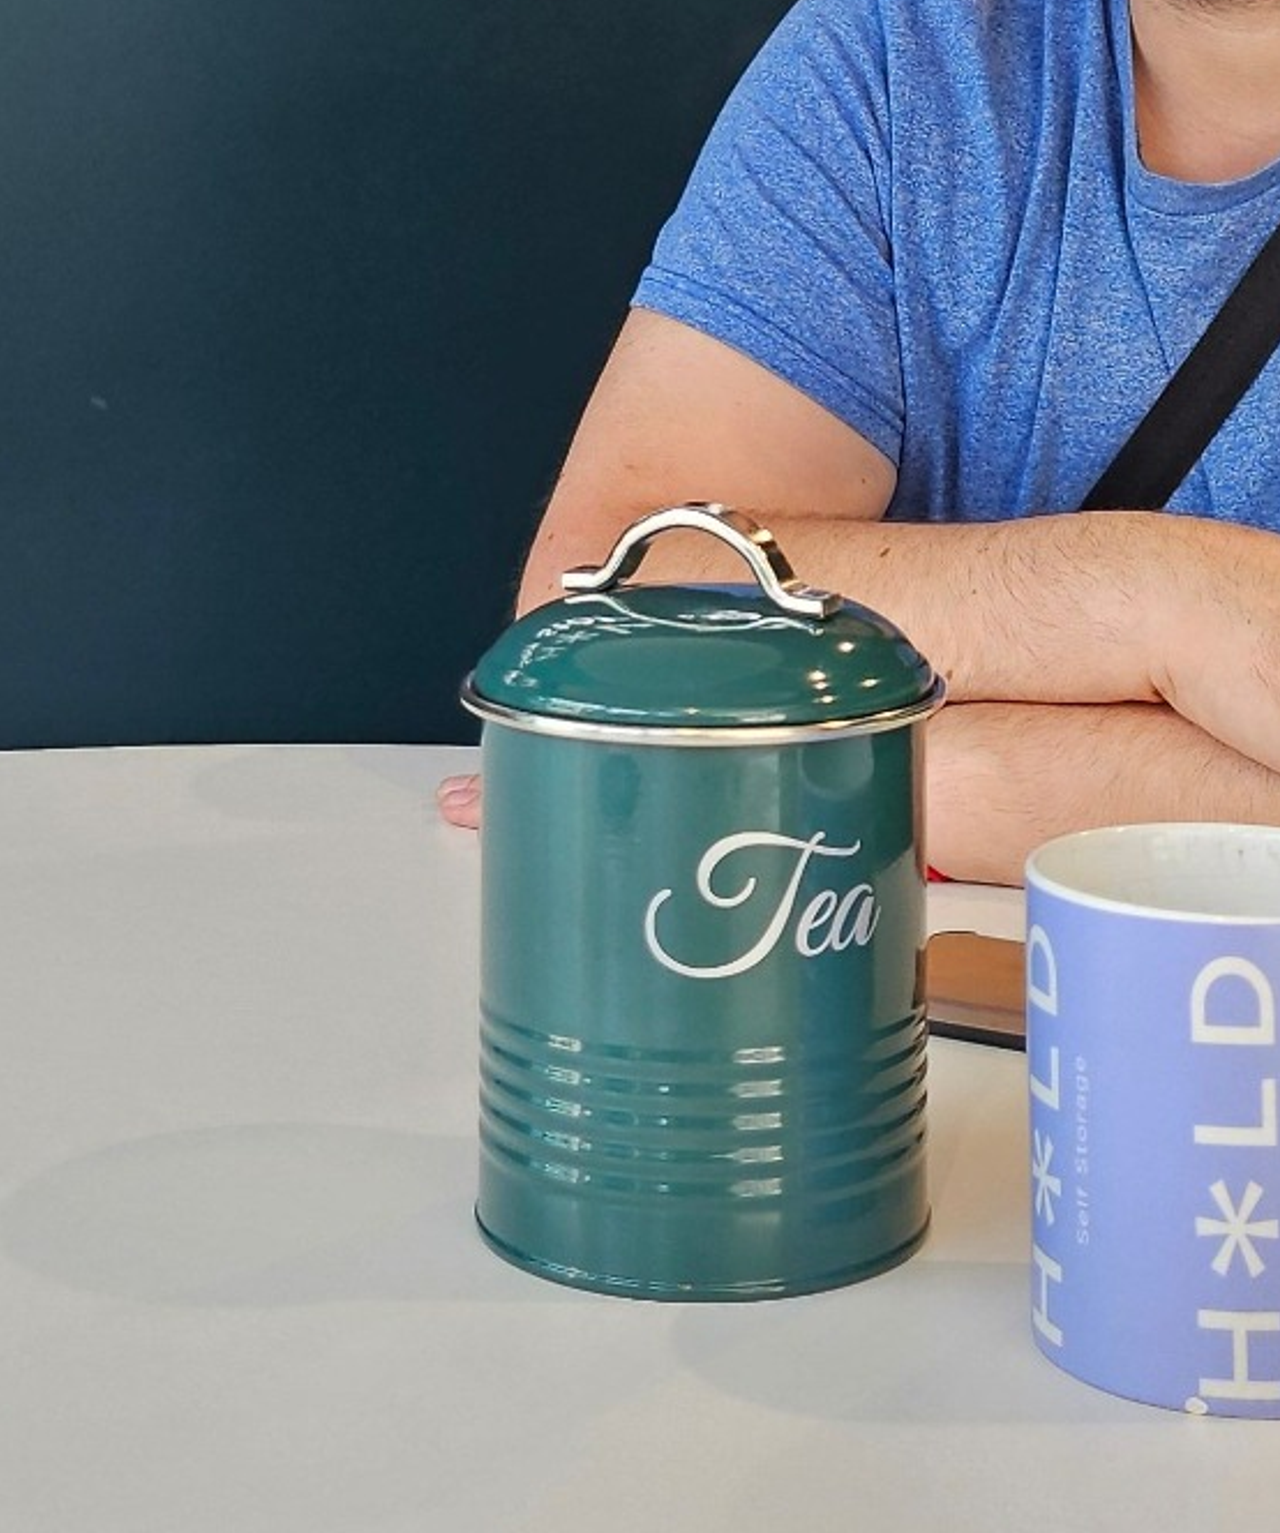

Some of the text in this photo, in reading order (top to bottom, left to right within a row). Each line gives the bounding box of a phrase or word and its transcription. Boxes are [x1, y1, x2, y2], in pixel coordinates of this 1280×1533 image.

[644, 830, 882, 979] Tea
[1075, 1055, 1090, 1246] Self Storage
